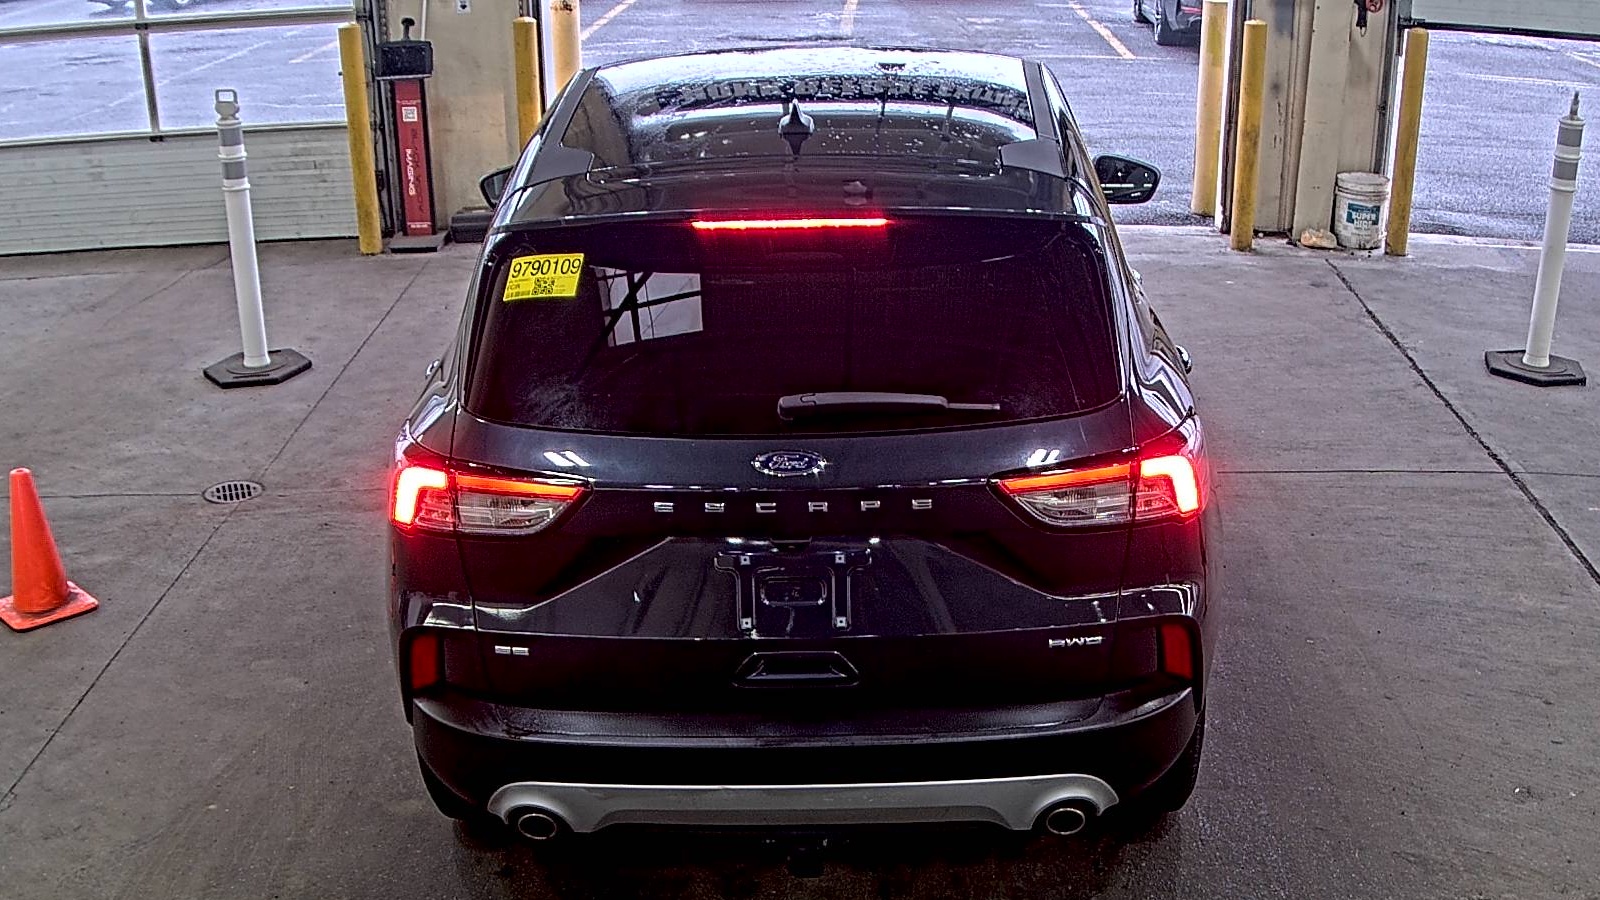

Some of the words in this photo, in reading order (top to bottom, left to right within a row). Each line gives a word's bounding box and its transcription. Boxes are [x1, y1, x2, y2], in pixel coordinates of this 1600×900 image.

[405, 148, 416, 196] IMAGING
[511, 258, 582, 279] 9790109
[653, 498, 933, 513] ESCAPE
[1048, 635, 1104, 649] AWD
[494, 645, 530, 656] SE
